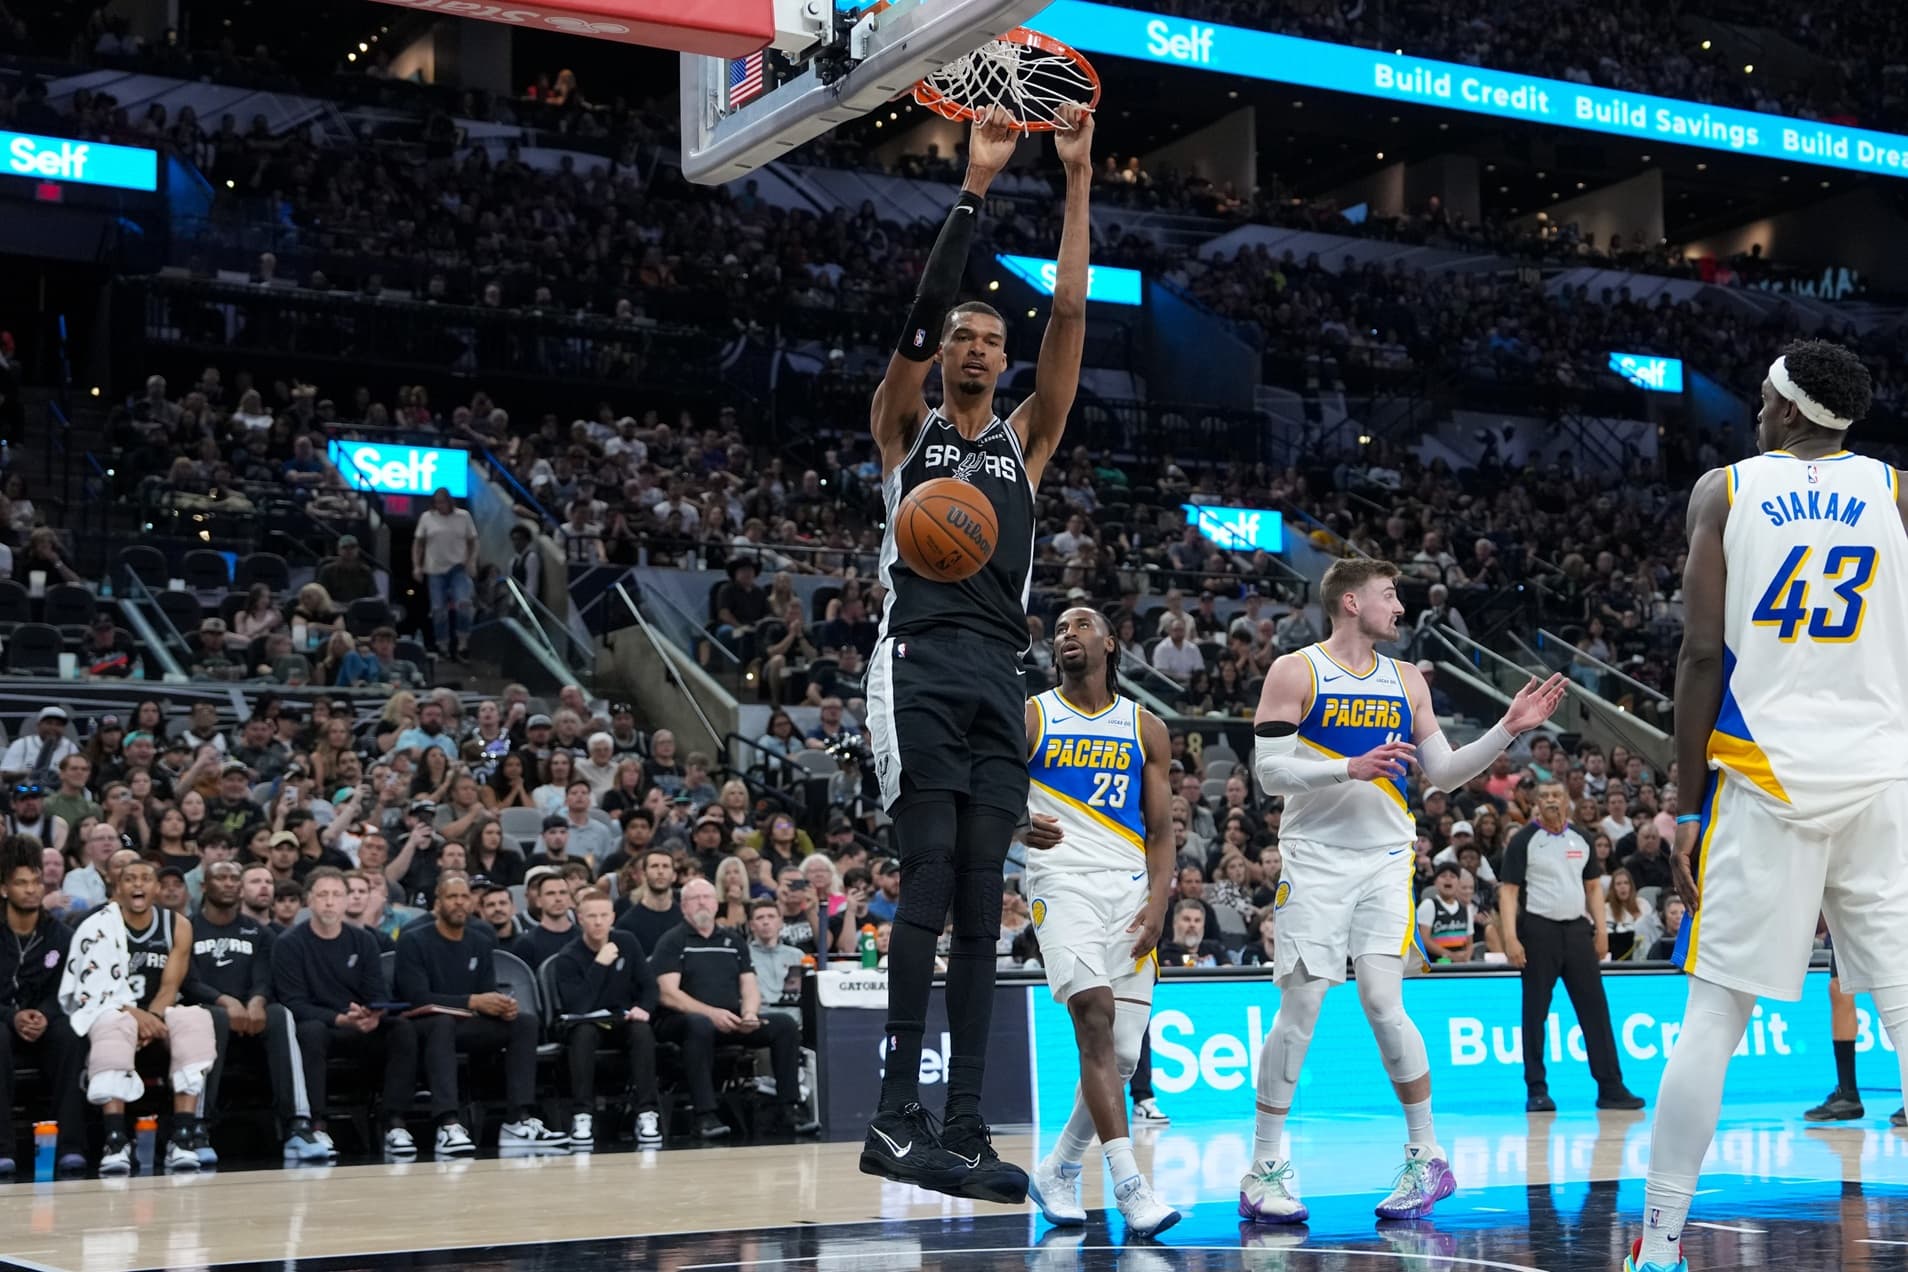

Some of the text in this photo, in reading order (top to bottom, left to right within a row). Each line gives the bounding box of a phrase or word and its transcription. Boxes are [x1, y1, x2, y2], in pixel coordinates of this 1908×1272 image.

[1147, 19, 1215, 63] Self
[1374, 63, 1451, 97] Build
[1575, 95, 1647, 129] Build
[1783, 128, 1849, 160] Build
[10, 137, 90, 179] Self
[353, 446, 439, 491] Self
[946, 505, 992, 556] Wilson
[1199, 510, 1261, 547] Self
[1761, 490, 1867, 528] SIAKAM
[1752, 545, 1881, 644] 43
[1321, 698, 1402, 729] PACERS
[1044, 738, 1133, 770] PACERS
[1088, 772, 1130, 808] 23
[1149, 1005, 1281, 1094] Sel
